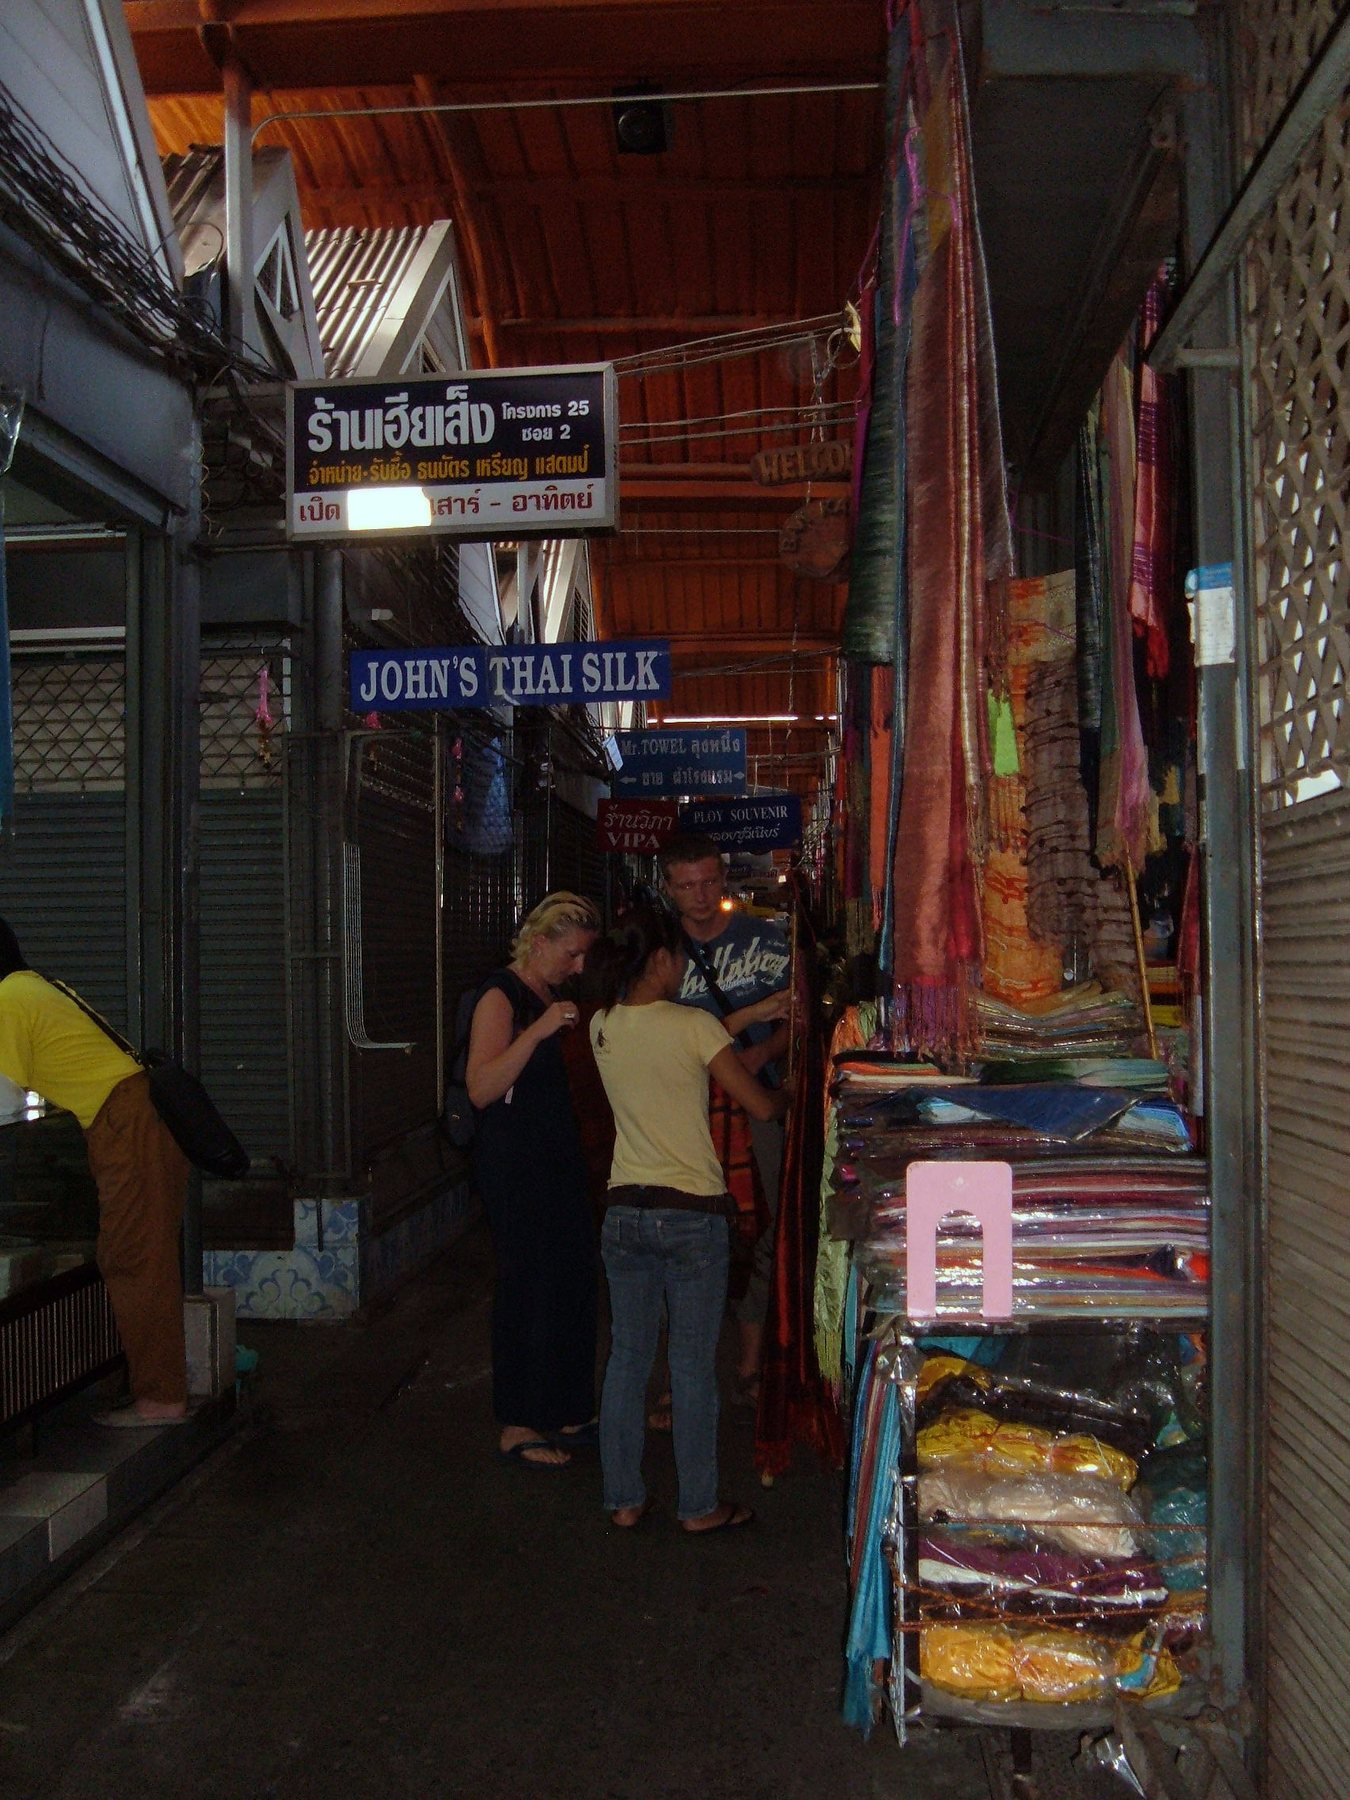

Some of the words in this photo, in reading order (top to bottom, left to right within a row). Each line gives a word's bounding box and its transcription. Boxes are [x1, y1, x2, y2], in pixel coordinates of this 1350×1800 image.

[501, 402, 562, 420] โครงการ
[567, 400, 590, 416] 25
[521, 427, 553, 441] ซอย
[559, 424, 571, 439] 2
[476, 451, 528, 481] เหรียญ
[299, 496, 341, 521] เปิด
[512, 483, 594, 512] อาทิตย์
[360, 655, 479, 702] JOHN'S
[489, 653, 574, 696] THAI
[582, 650, 660, 693] SILK
[693, 810, 722, 825] PLOY
[730, 805, 789, 822] SOUVENIR
[607, 832, 661, 849] VIPA
